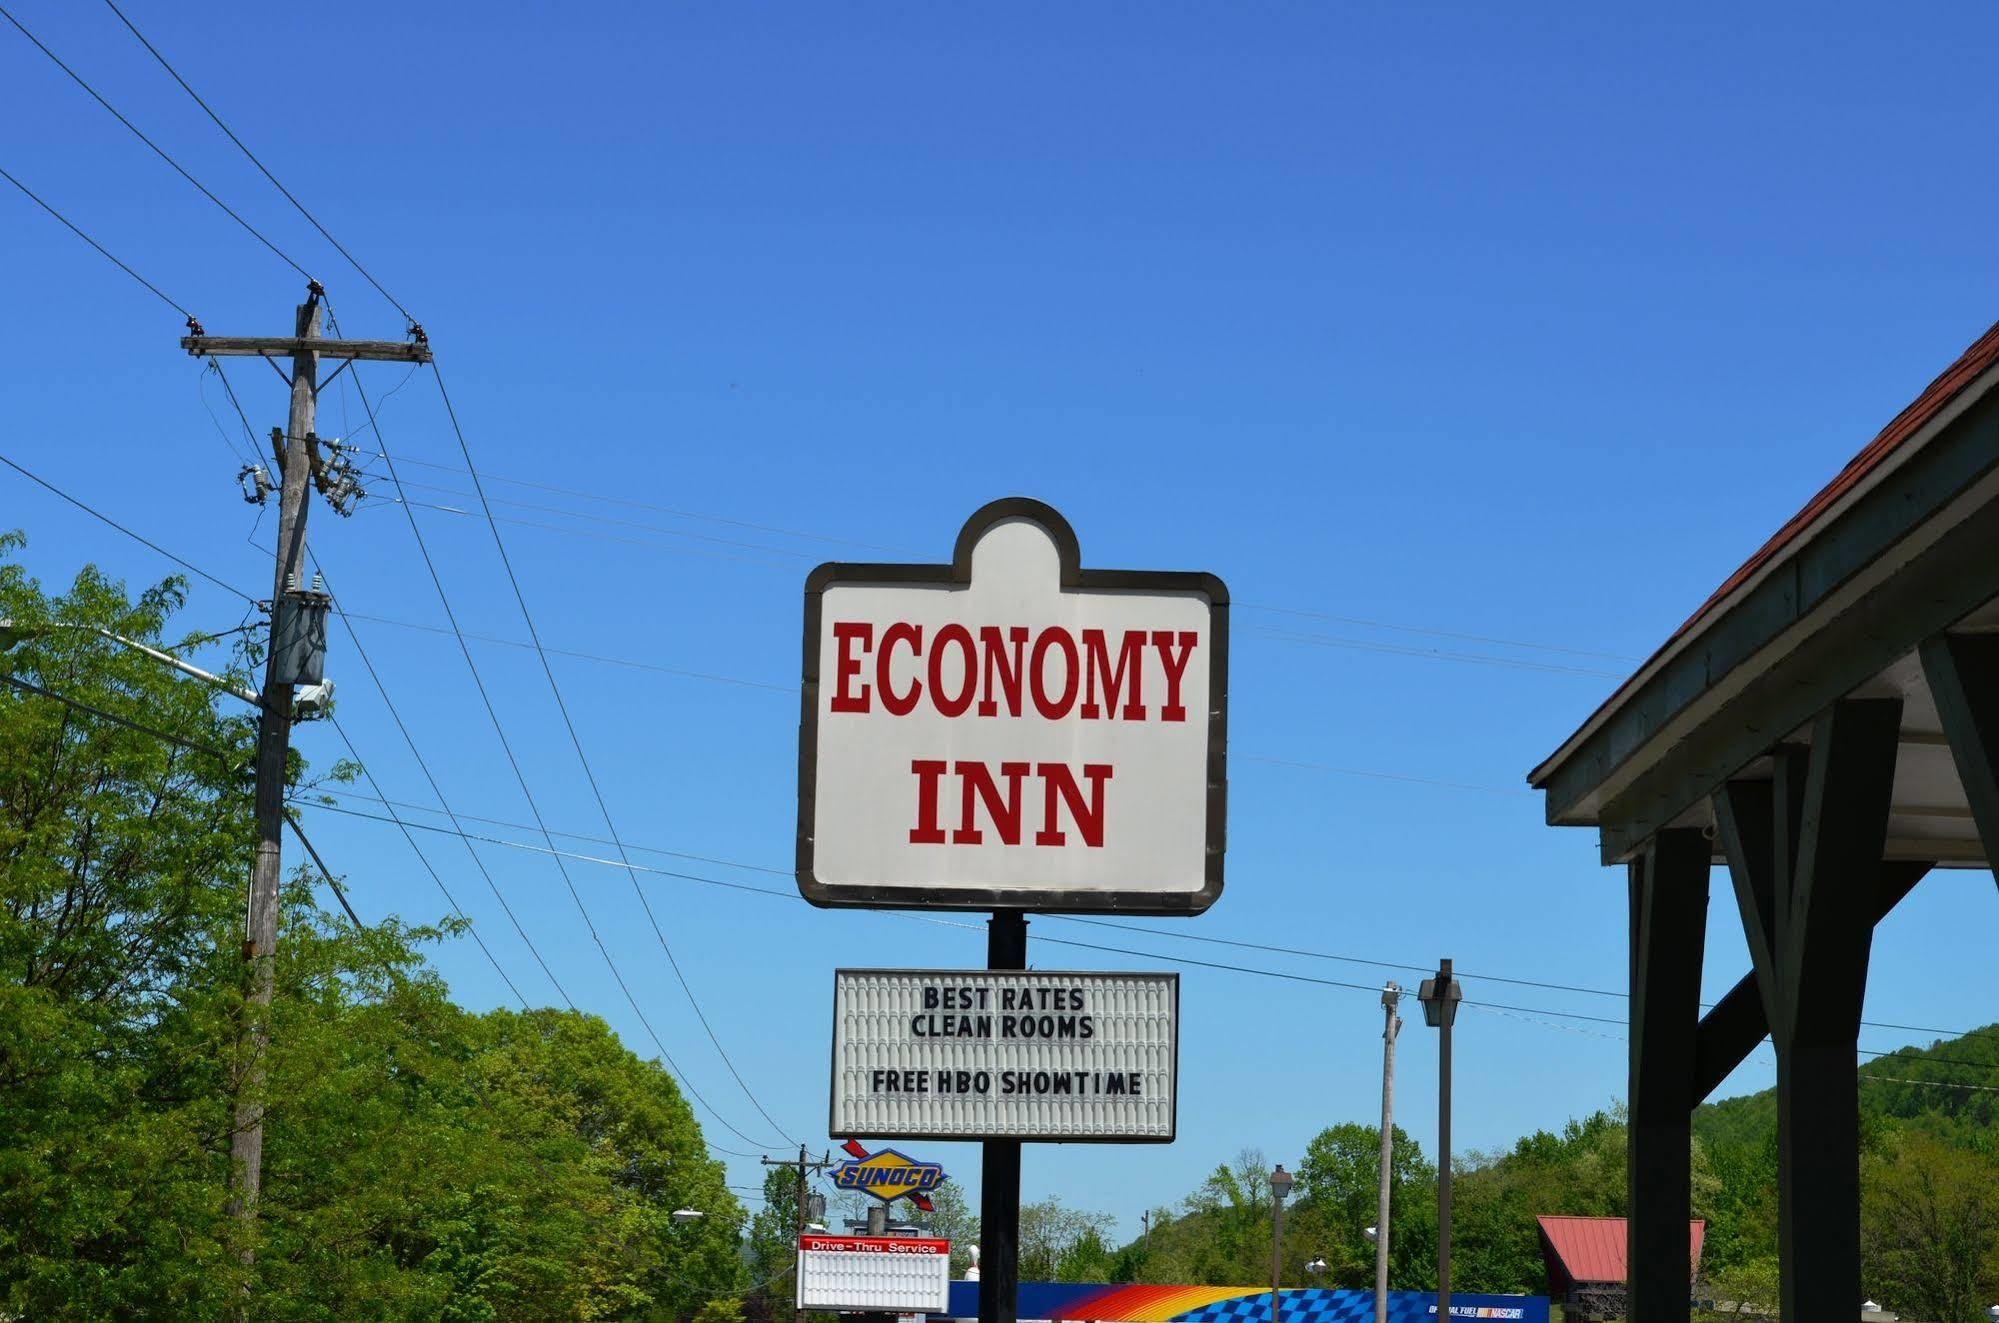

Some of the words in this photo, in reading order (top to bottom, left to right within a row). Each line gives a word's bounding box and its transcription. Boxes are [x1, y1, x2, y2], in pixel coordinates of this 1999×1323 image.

[830, 622, 1198, 722] ECONOMY
[908, 759, 1113, 848] INN
[924, 986, 990, 1010] BEST
[1002, 987, 1084, 1011] RATES
[912, 1014, 992, 1038] CLEAN
[1002, 1015, 1093, 1039] ROOMS
[872, 1069, 929, 1093] FREE
[937, 1070, 990, 1094] HBO
[1002, 1071, 1141, 1096] SHOWTIME
[840, 1166, 937, 1186] SUNOCO
[811, 1241, 882, 1252] Drive-Thru
[889, 1242, 937, 1253] Service
[1490, 1307, 1521, 1318] NASCAR
